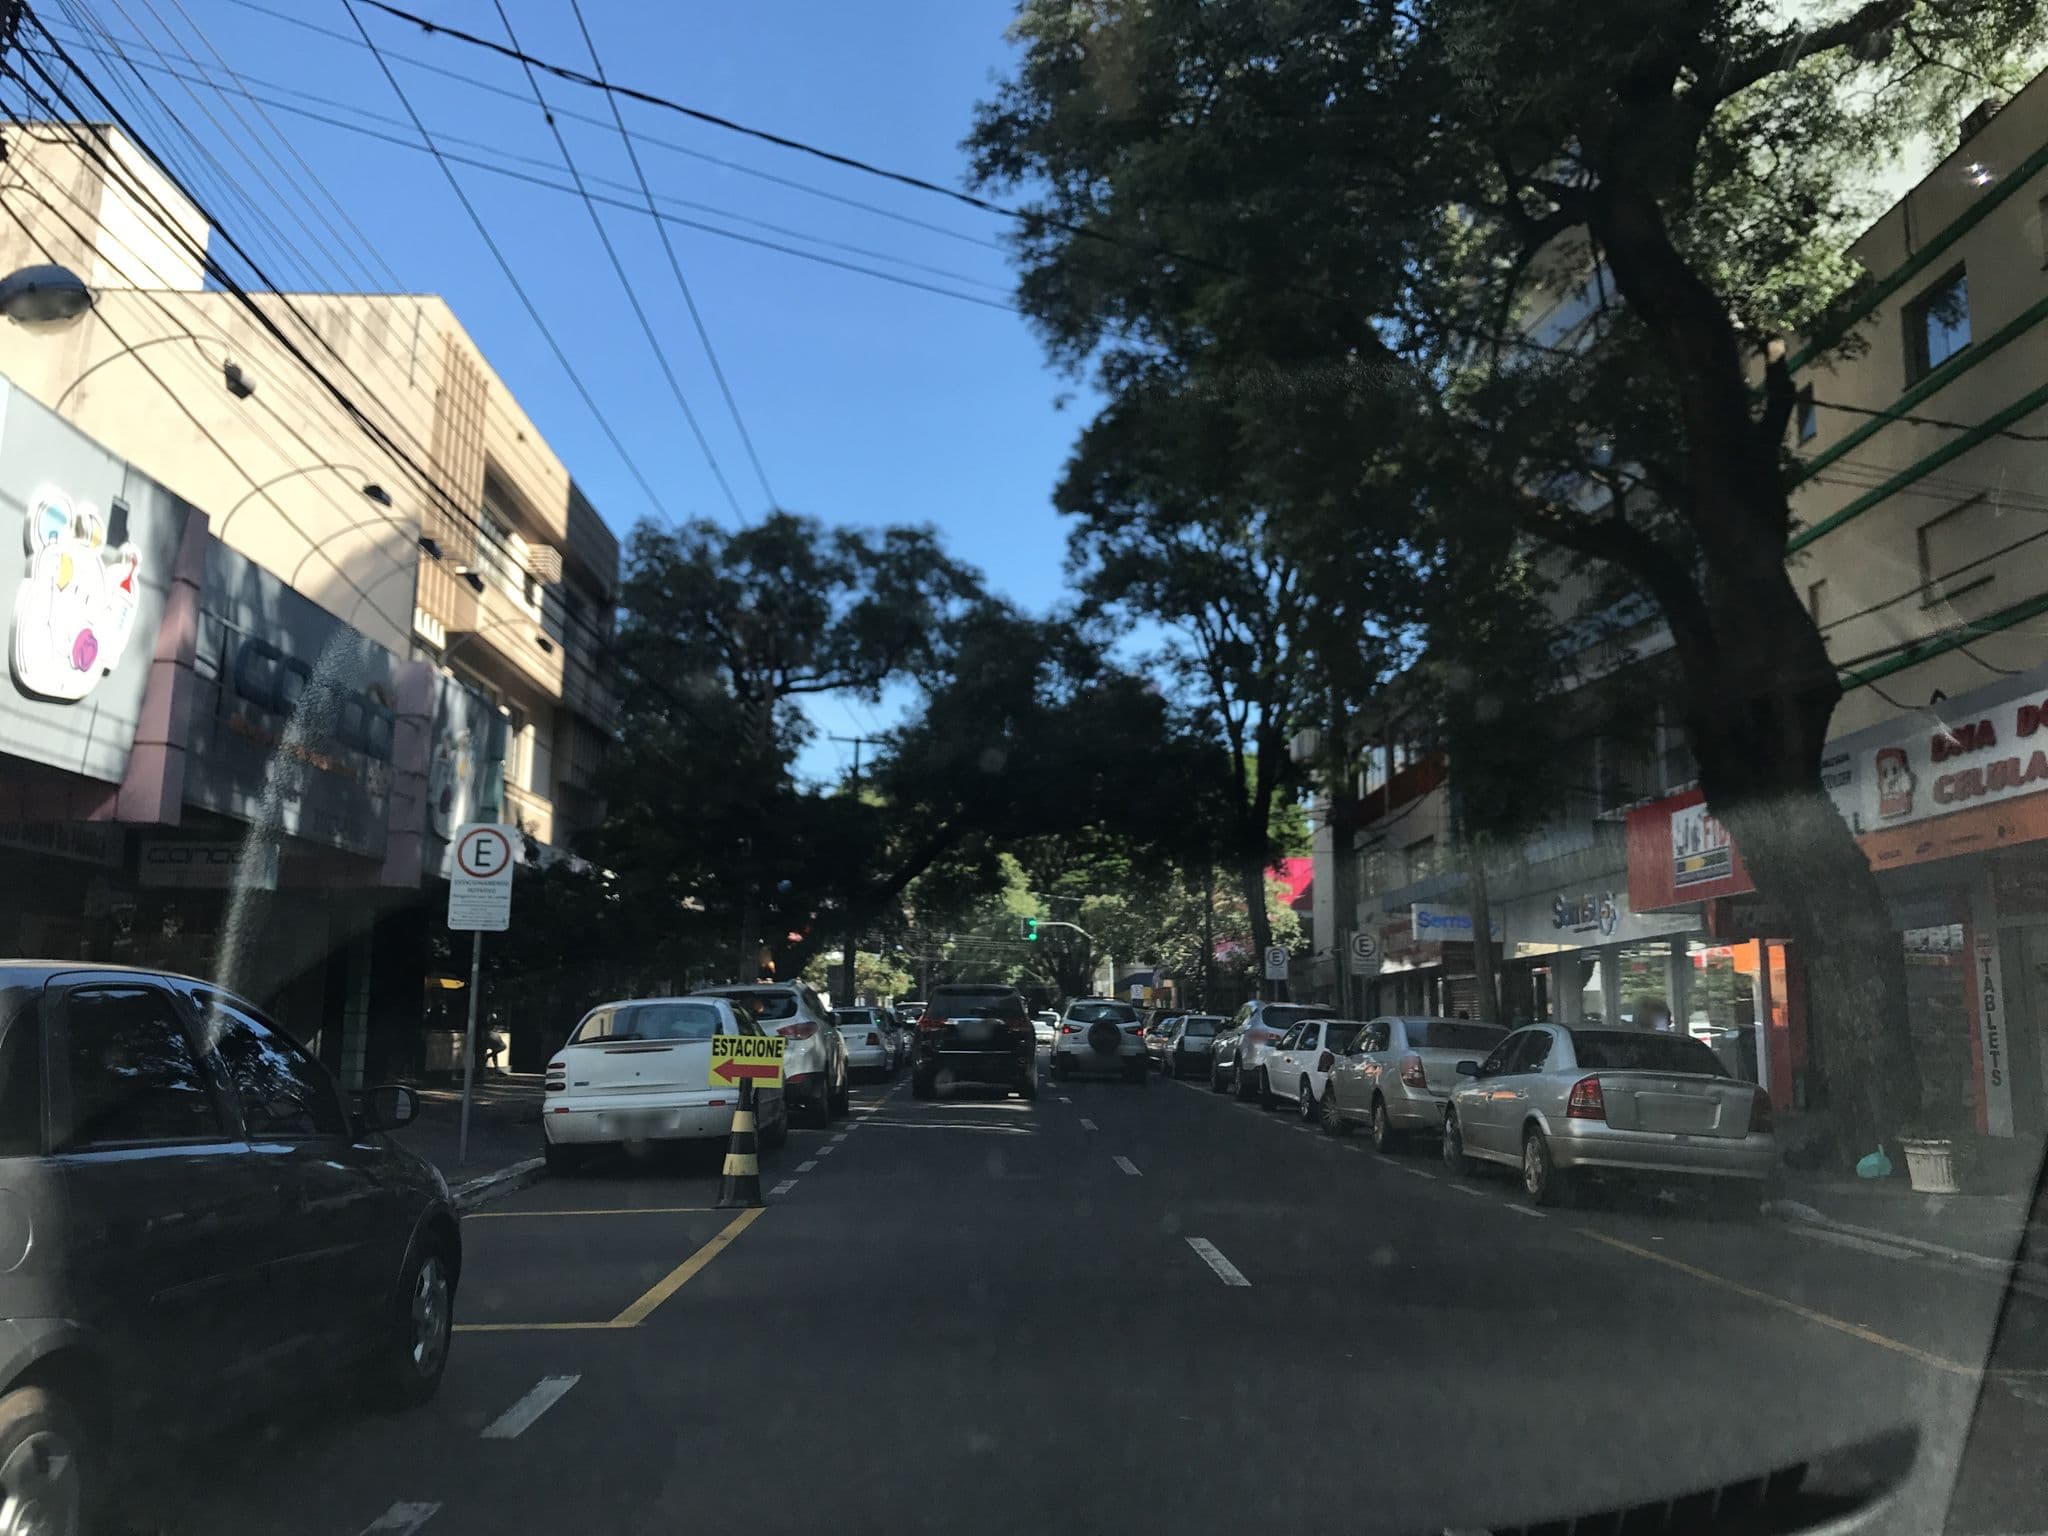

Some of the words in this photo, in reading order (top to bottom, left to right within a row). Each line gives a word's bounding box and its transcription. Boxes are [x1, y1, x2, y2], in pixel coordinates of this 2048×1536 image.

[475, 838, 492, 867] E
[1272, 951, 1281, 961] E
[1359, 938, 1370, 953] E
[1980, 957, 2002, 1087] TABLETS
[712, 1037, 784, 1058] ESTACIONE
